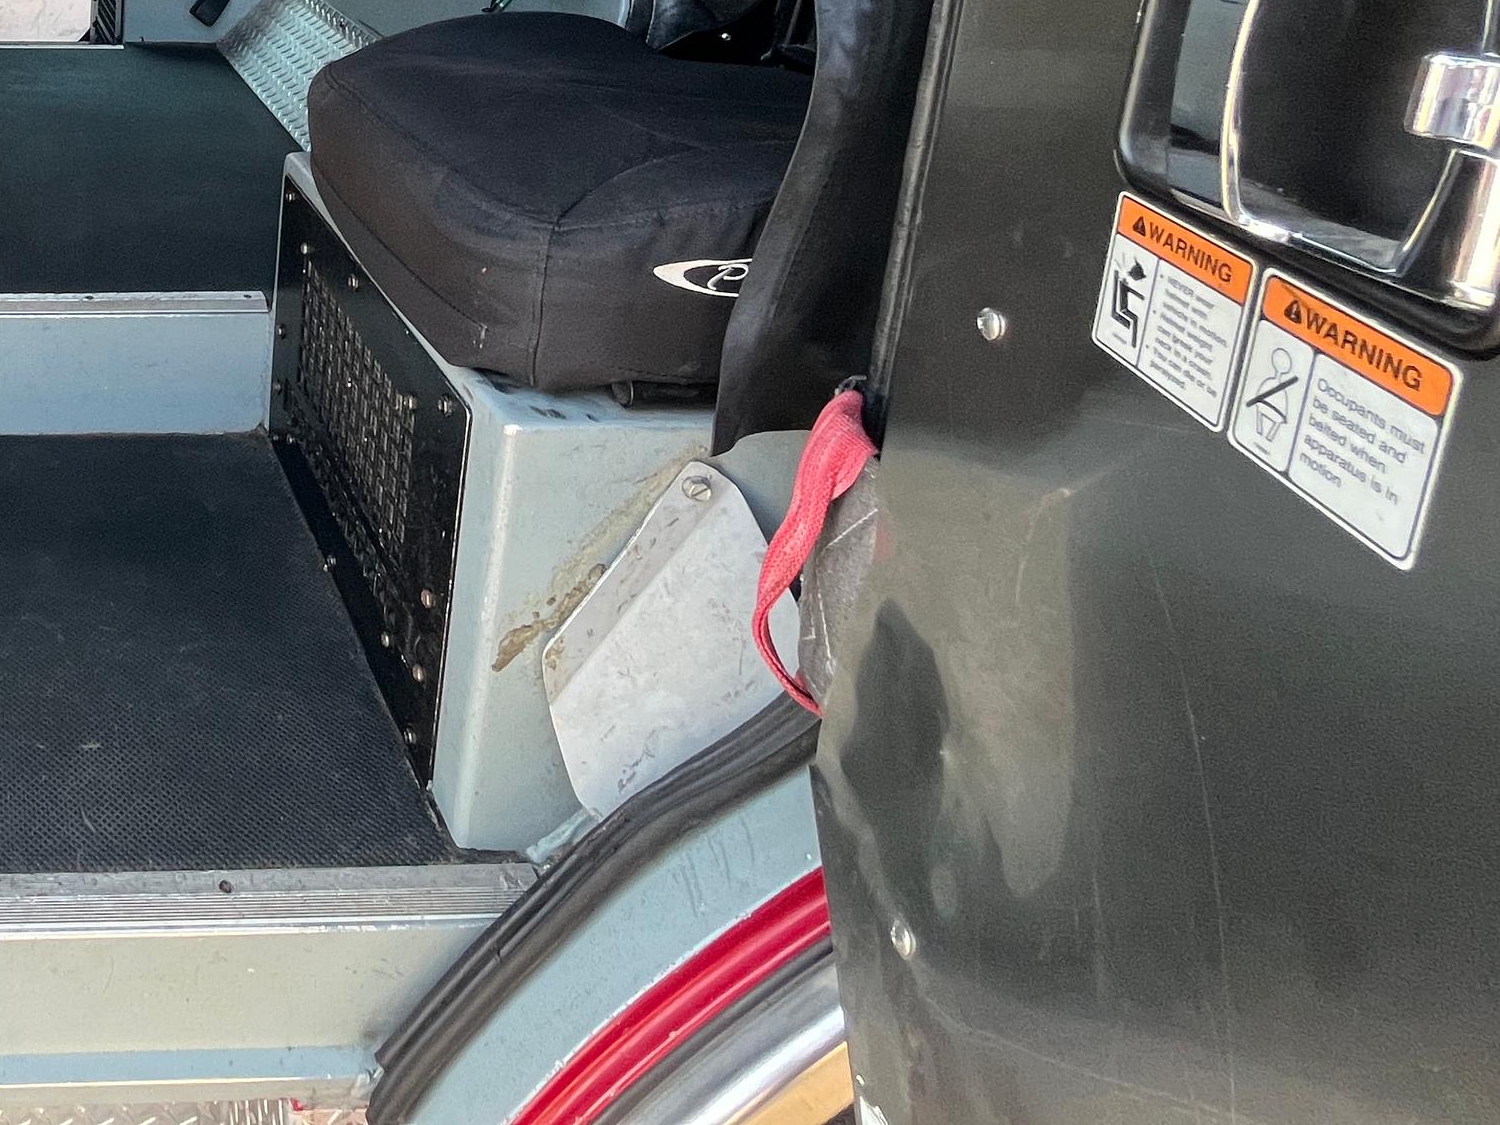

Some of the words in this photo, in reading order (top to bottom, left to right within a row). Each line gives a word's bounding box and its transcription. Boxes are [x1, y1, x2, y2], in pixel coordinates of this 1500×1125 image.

[1149, 221, 1232, 283] WARNING
[1167, 275, 1195, 297] NEVER
[1305, 307, 1423, 391] WARNING
[1308, 413, 1348, 446] belted
[1350, 443, 1388, 473] when
[1312, 395, 1329, 414] be
[1331, 410, 1377, 444] seated
[1378, 440, 1408, 464] and
[1318, 378, 1387, 429] Occupants
[1390, 425, 1427, 454] must
[1299, 452, 1342, 488] motion
[1303, 434, 1368, 483] apparatus
[1370, 476, 1382, 493] is
[1385, 486, 1399, 505] in
